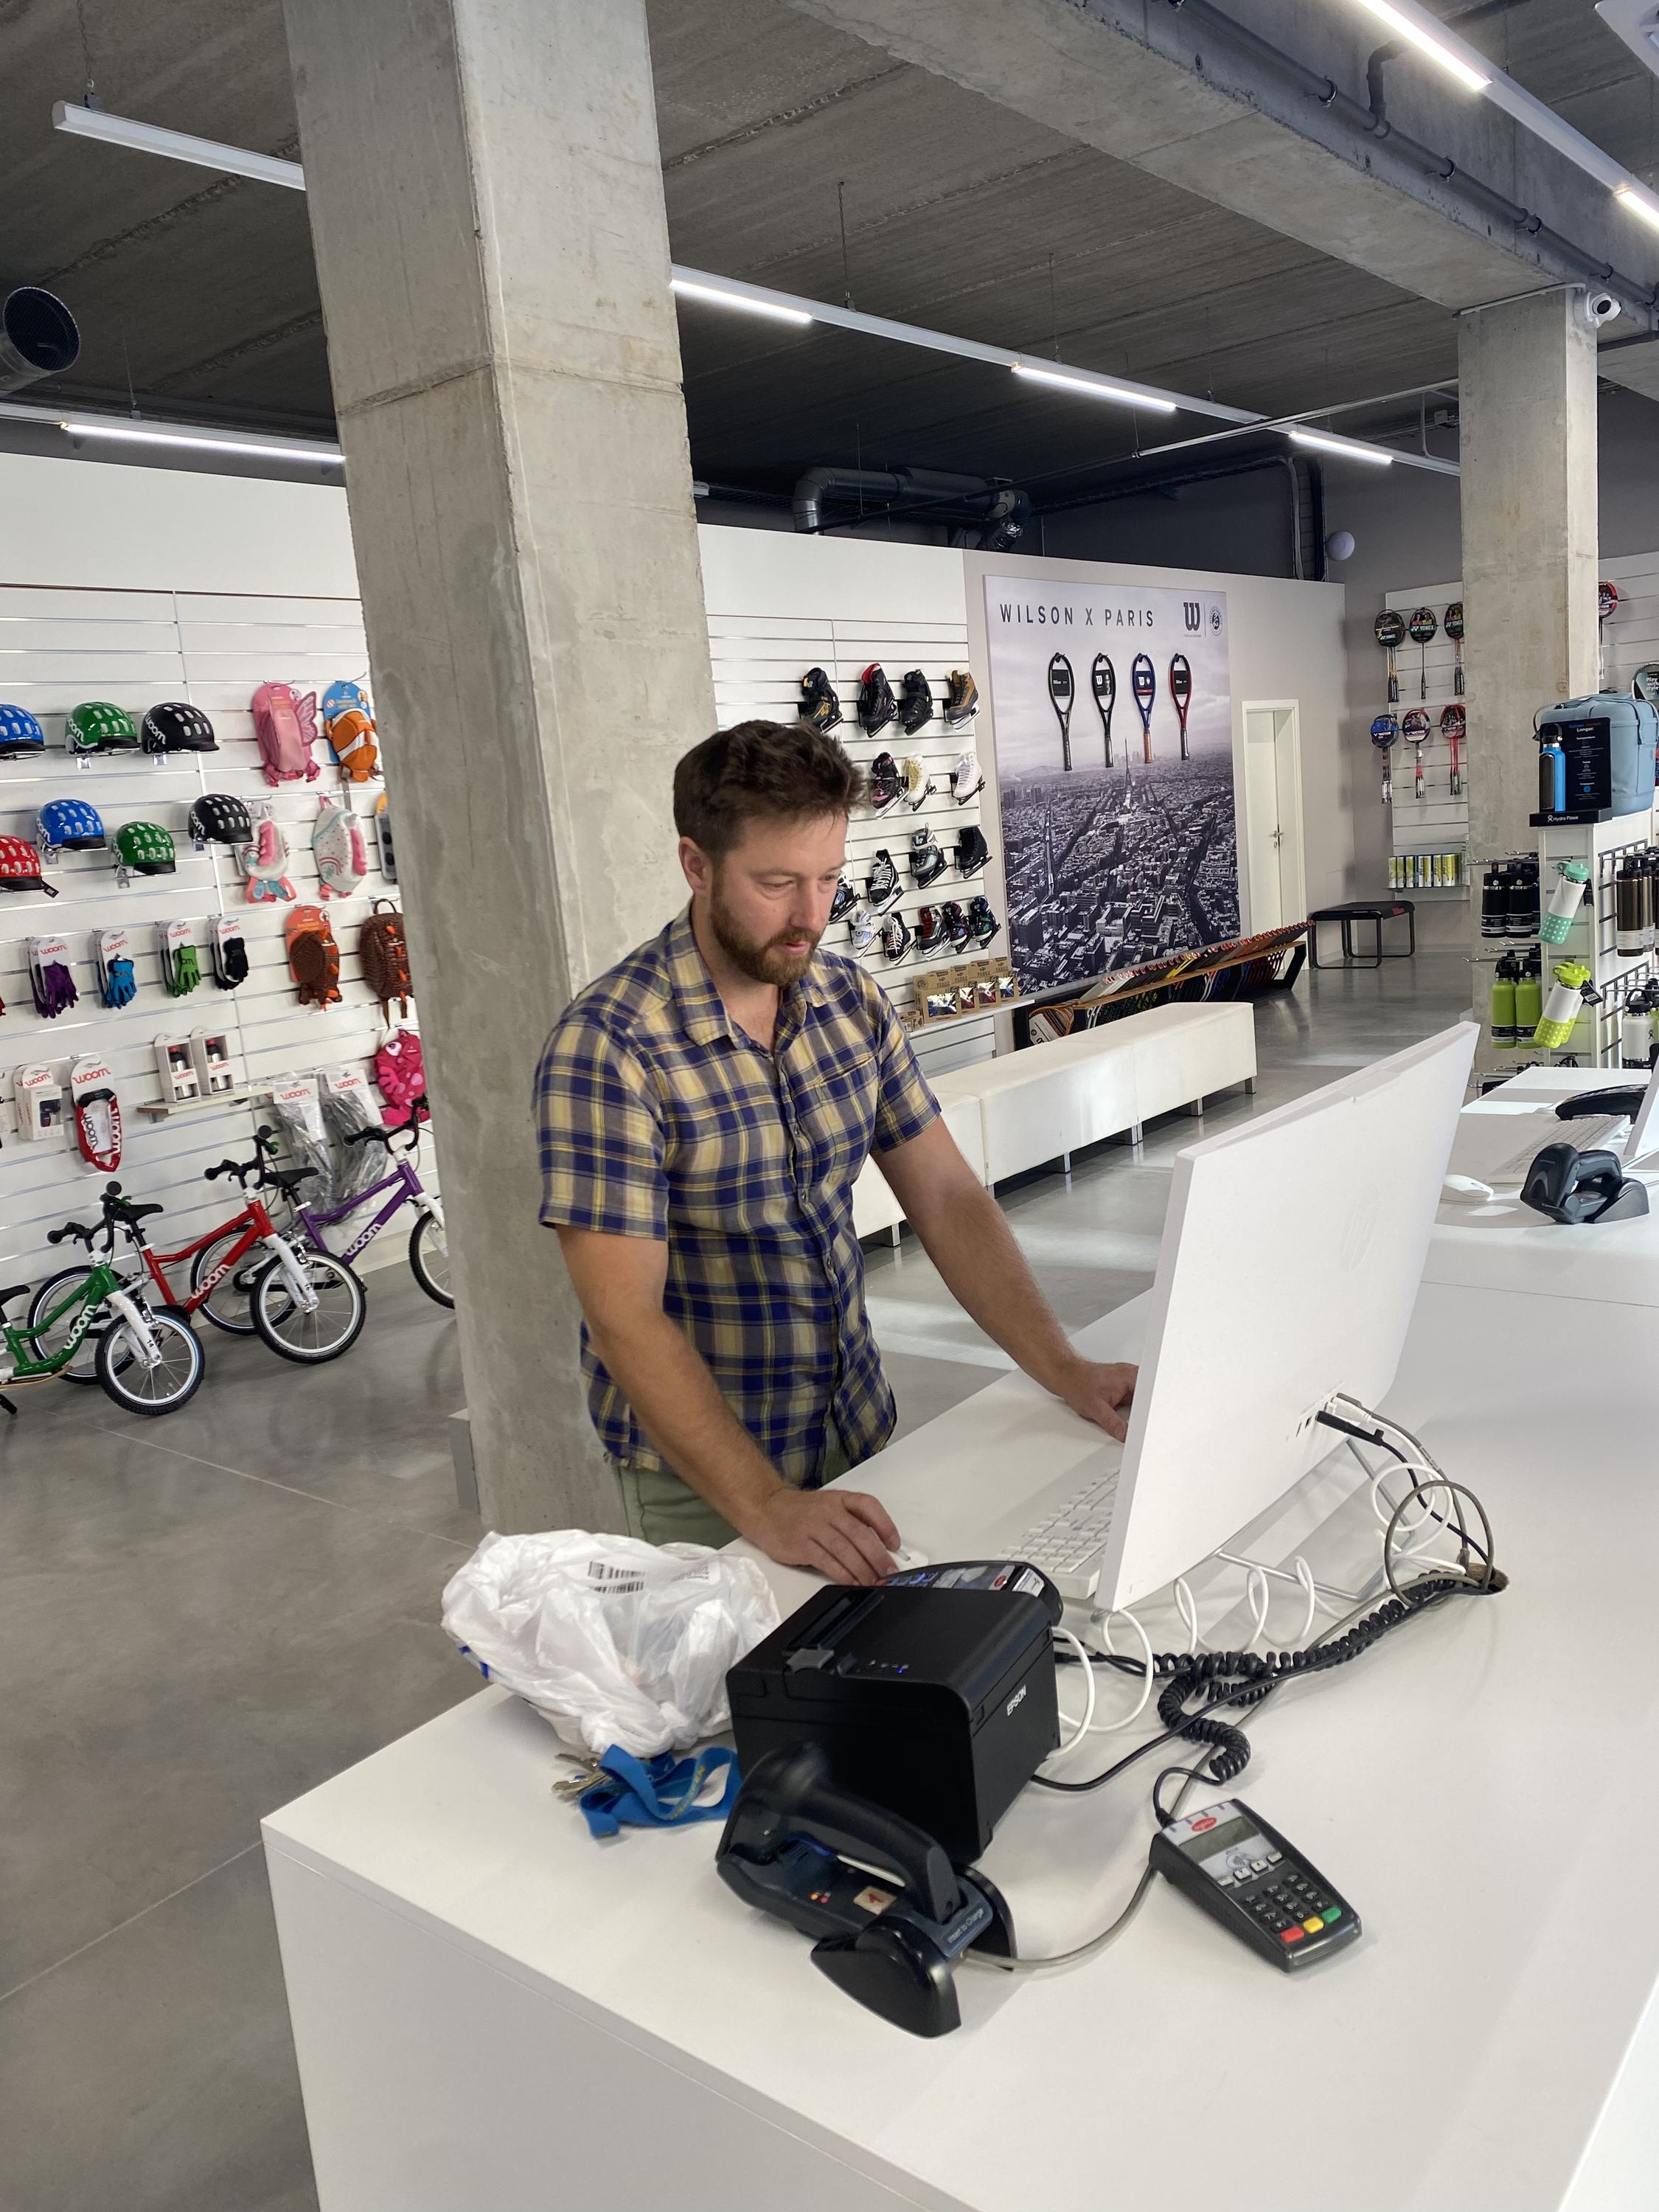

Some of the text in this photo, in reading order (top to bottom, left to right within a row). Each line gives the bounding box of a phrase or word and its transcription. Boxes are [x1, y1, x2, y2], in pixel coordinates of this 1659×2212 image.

[999, 603, 1154, 627] WILSON X PARIS
[37, 818, 51, 843] oom
[170, 928, 192, 938] woom
[219, 925, 240, 935] woom
[40, 945, 67, 955] woom
[103, 939, 128, 952] woom
[210, 1062, 229, 1071] woom
[24, 1073, 51, 1087] woom
[72, 1068, 112, 1084] woom
[173, 1071, 194, 1079] woom
[334, 1077, 361, 1089] woom
[280, 1088, 311, 1100] woom
[83, 1113, 98, 1149] woom
[347, 1223, 382, 1256] woom
[191, 1264, 231, 1299] woom
[63, 1304, 99, 1350] woom
[1006, 1684, 1026, 1717] EPSON
